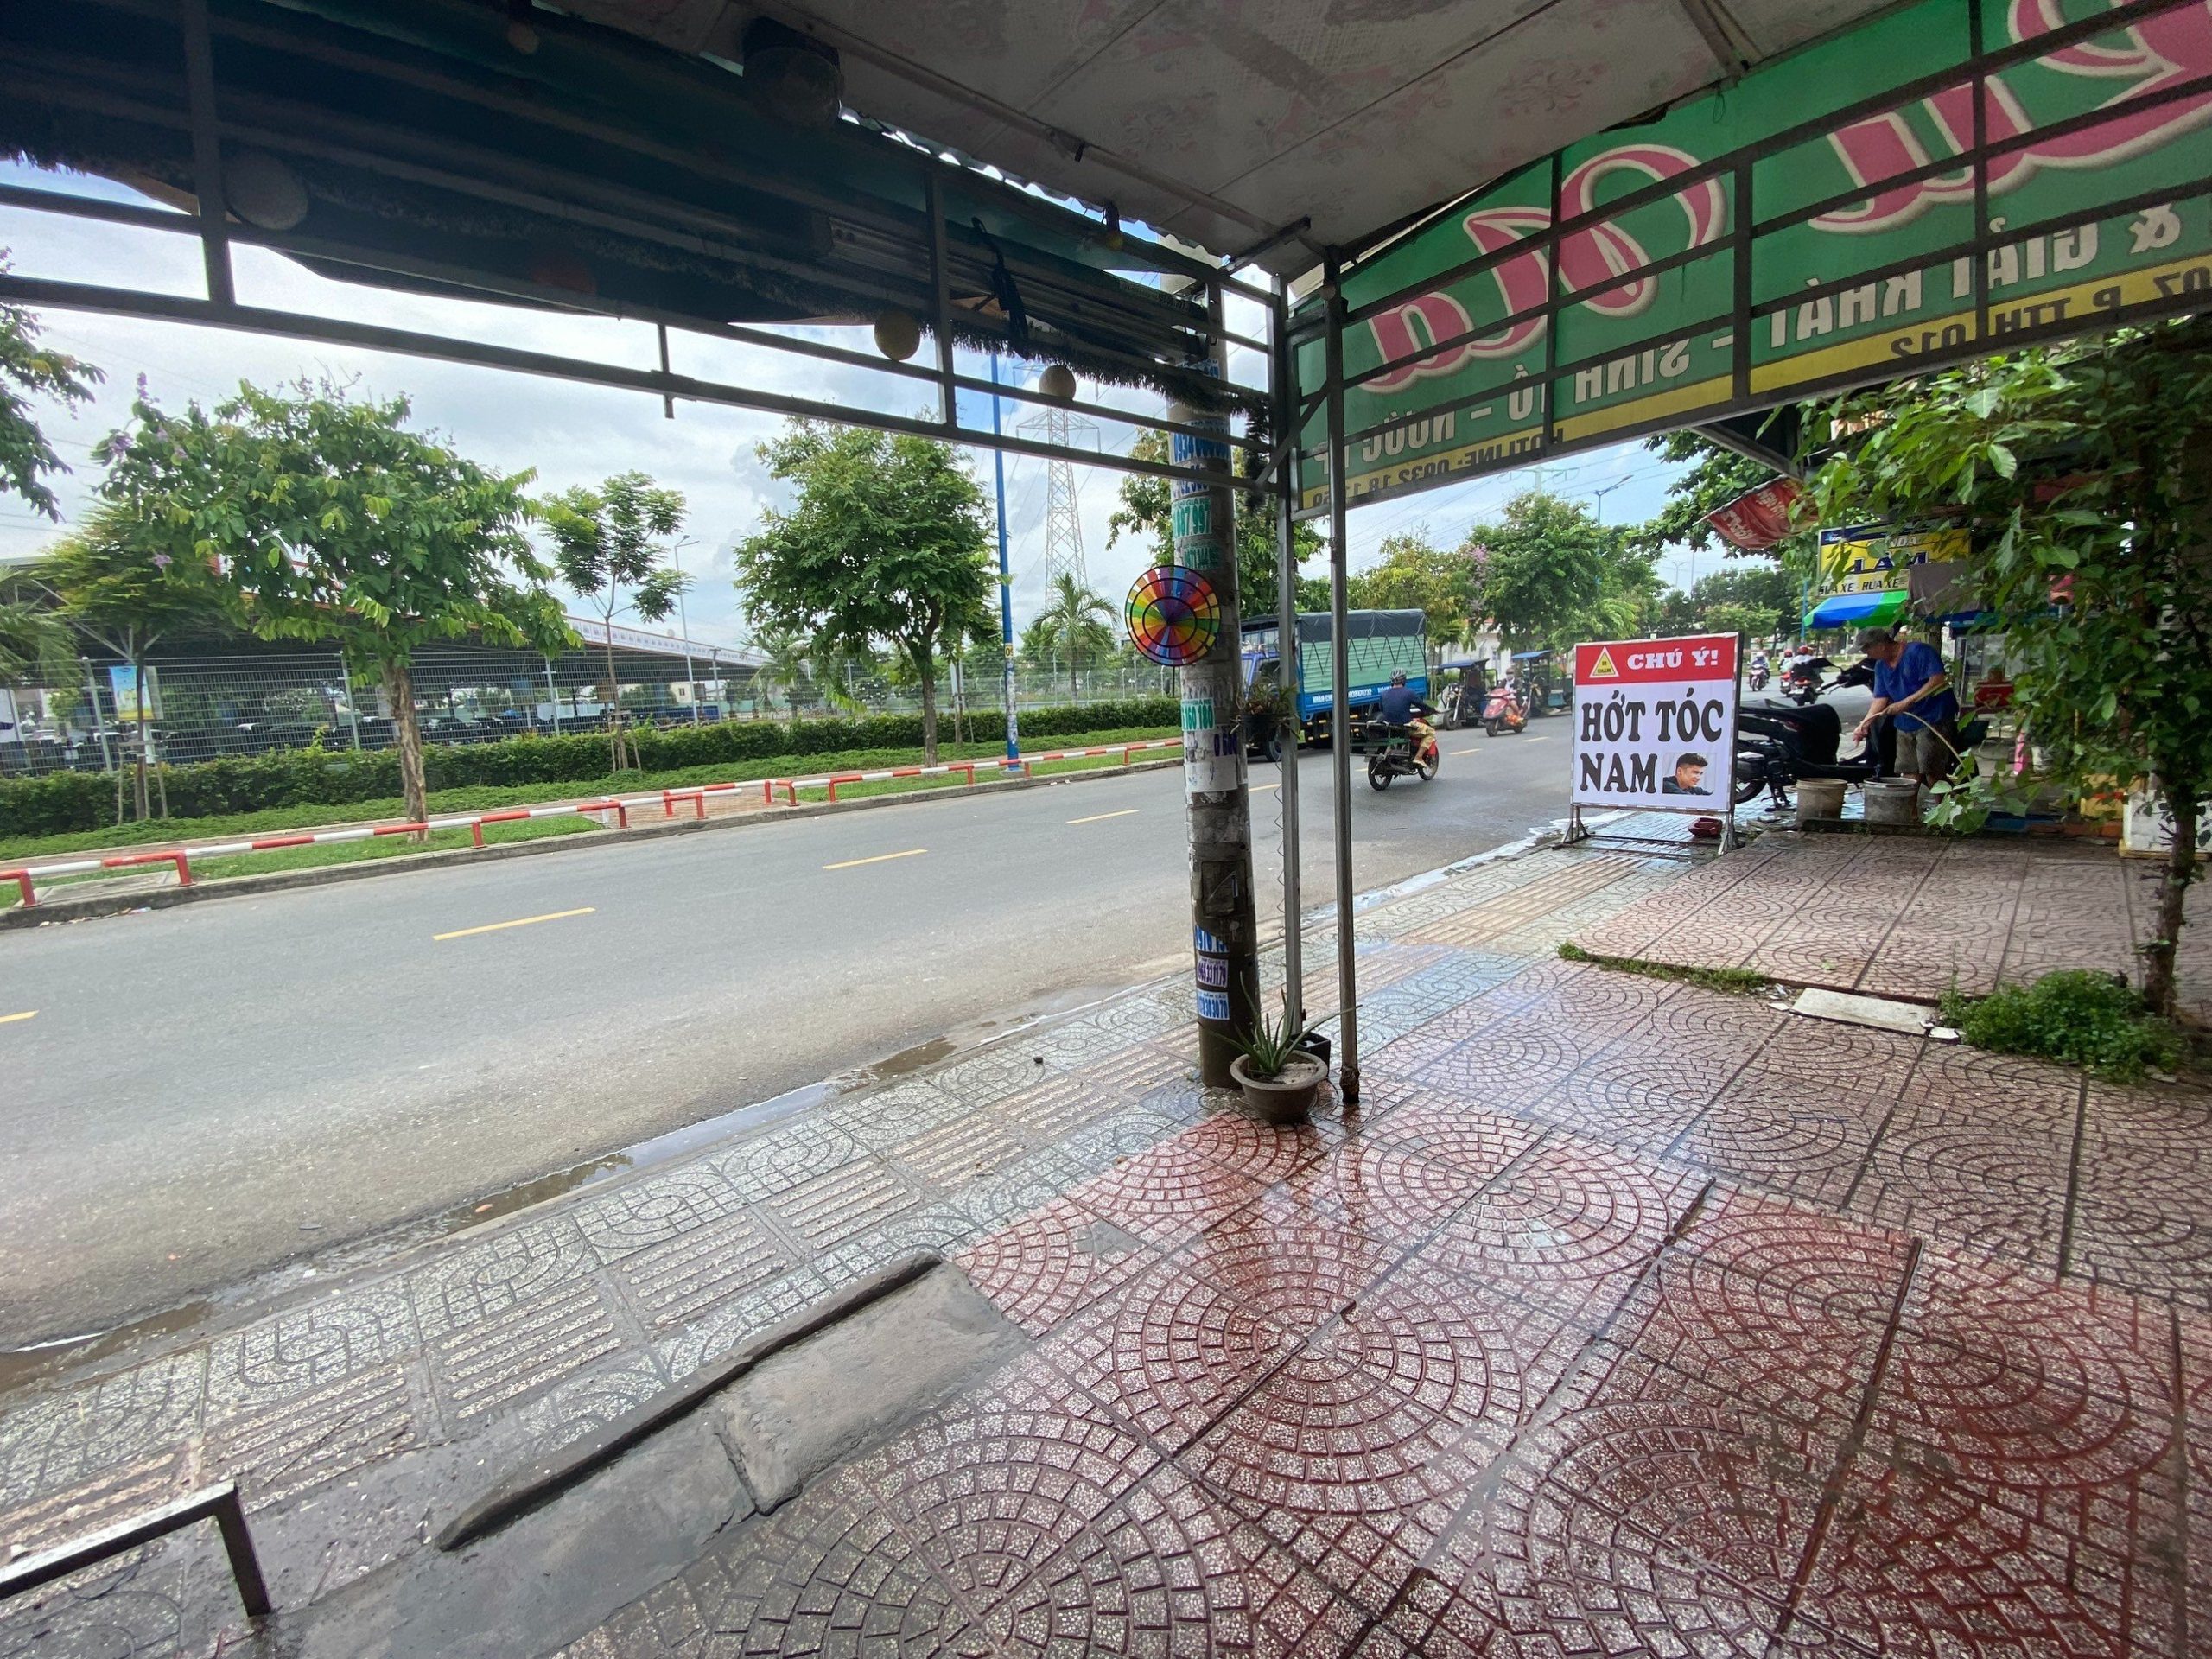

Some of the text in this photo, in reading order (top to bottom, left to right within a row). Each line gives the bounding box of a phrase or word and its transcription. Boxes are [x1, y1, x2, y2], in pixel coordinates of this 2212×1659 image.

[1627, 646, 1719, 671] CHÚ Ý!
[1580, 687, 1724, 742] HỚT TÓC
[1580, 752, 1658, 794] NAM
